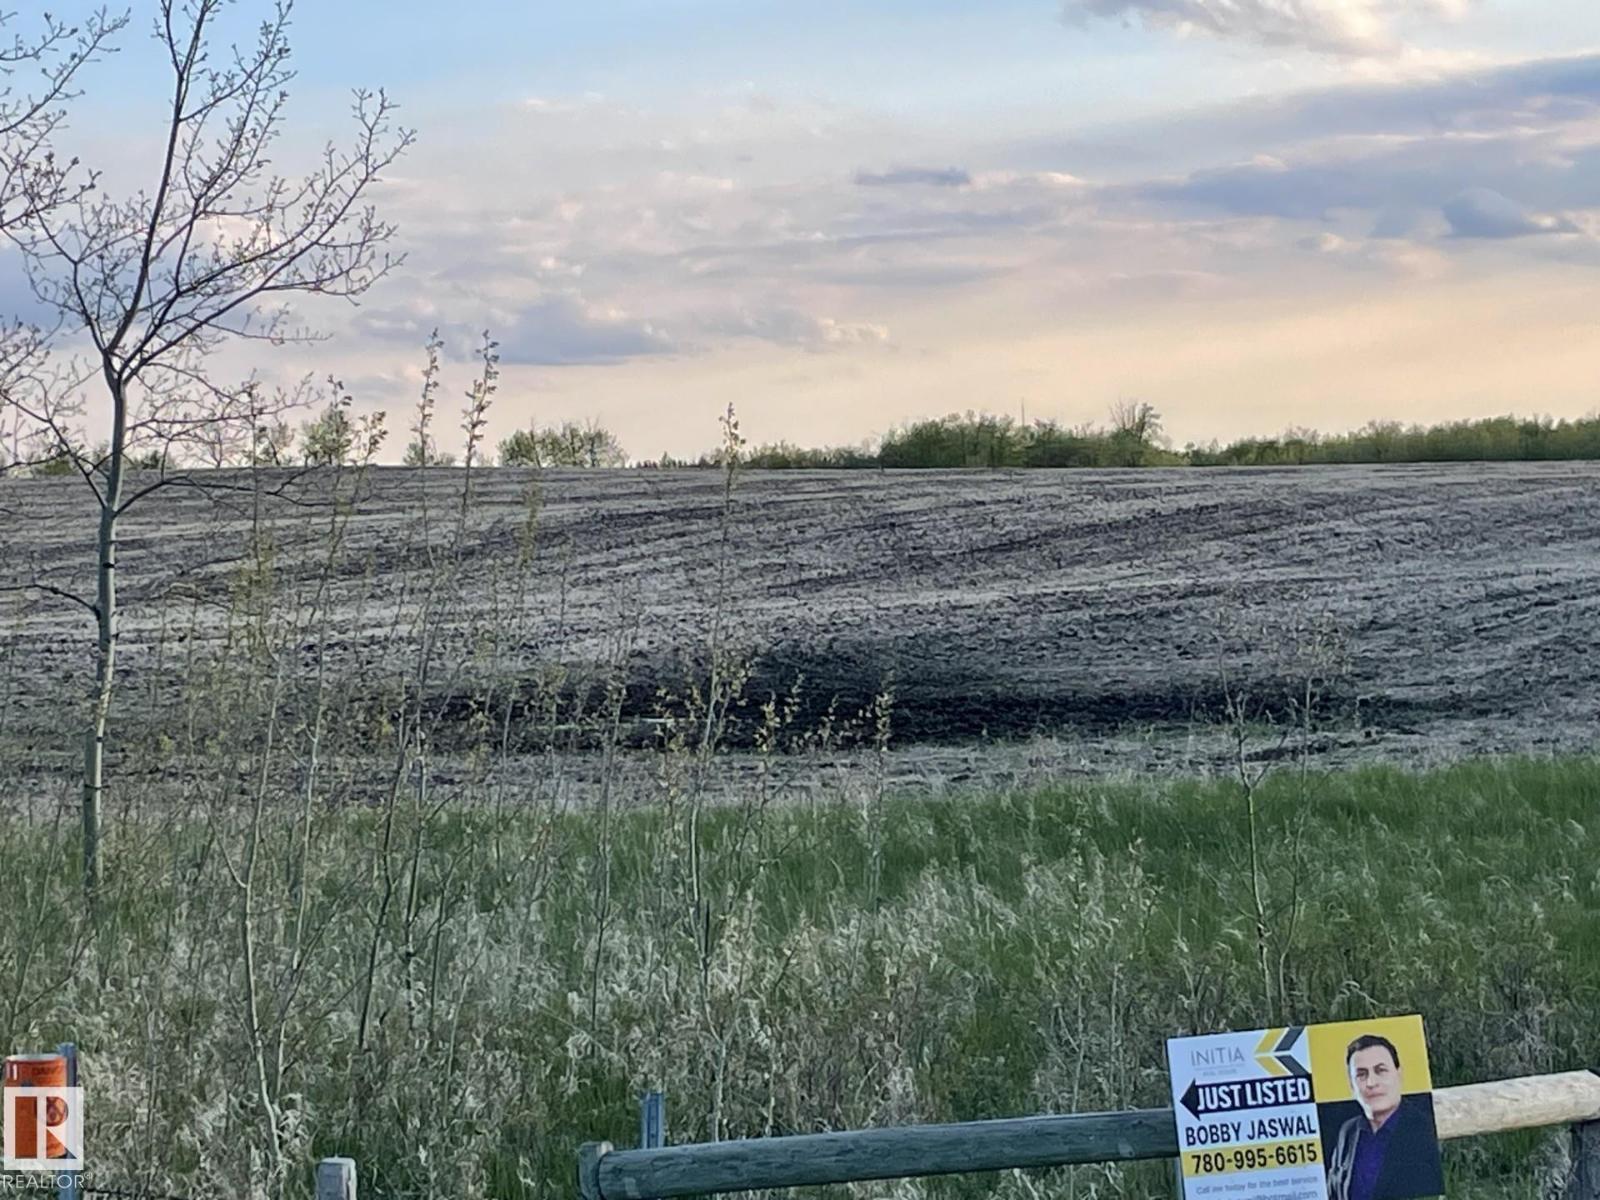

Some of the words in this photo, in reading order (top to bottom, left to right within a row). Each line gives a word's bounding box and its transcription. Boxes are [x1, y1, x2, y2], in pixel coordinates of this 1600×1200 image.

[1191, 1046, 1245, 1066] INITIA
[1197, 1084, 1241, 1111] JUST
[1246, 1078, 1310, 1106] LISTED
[1186, 1121, 1241, 1146] BOBBY
[1247, 1115, 1316, 1140] JASWAL
[1192, 1143, 1317, 1173] 780-995-6615
